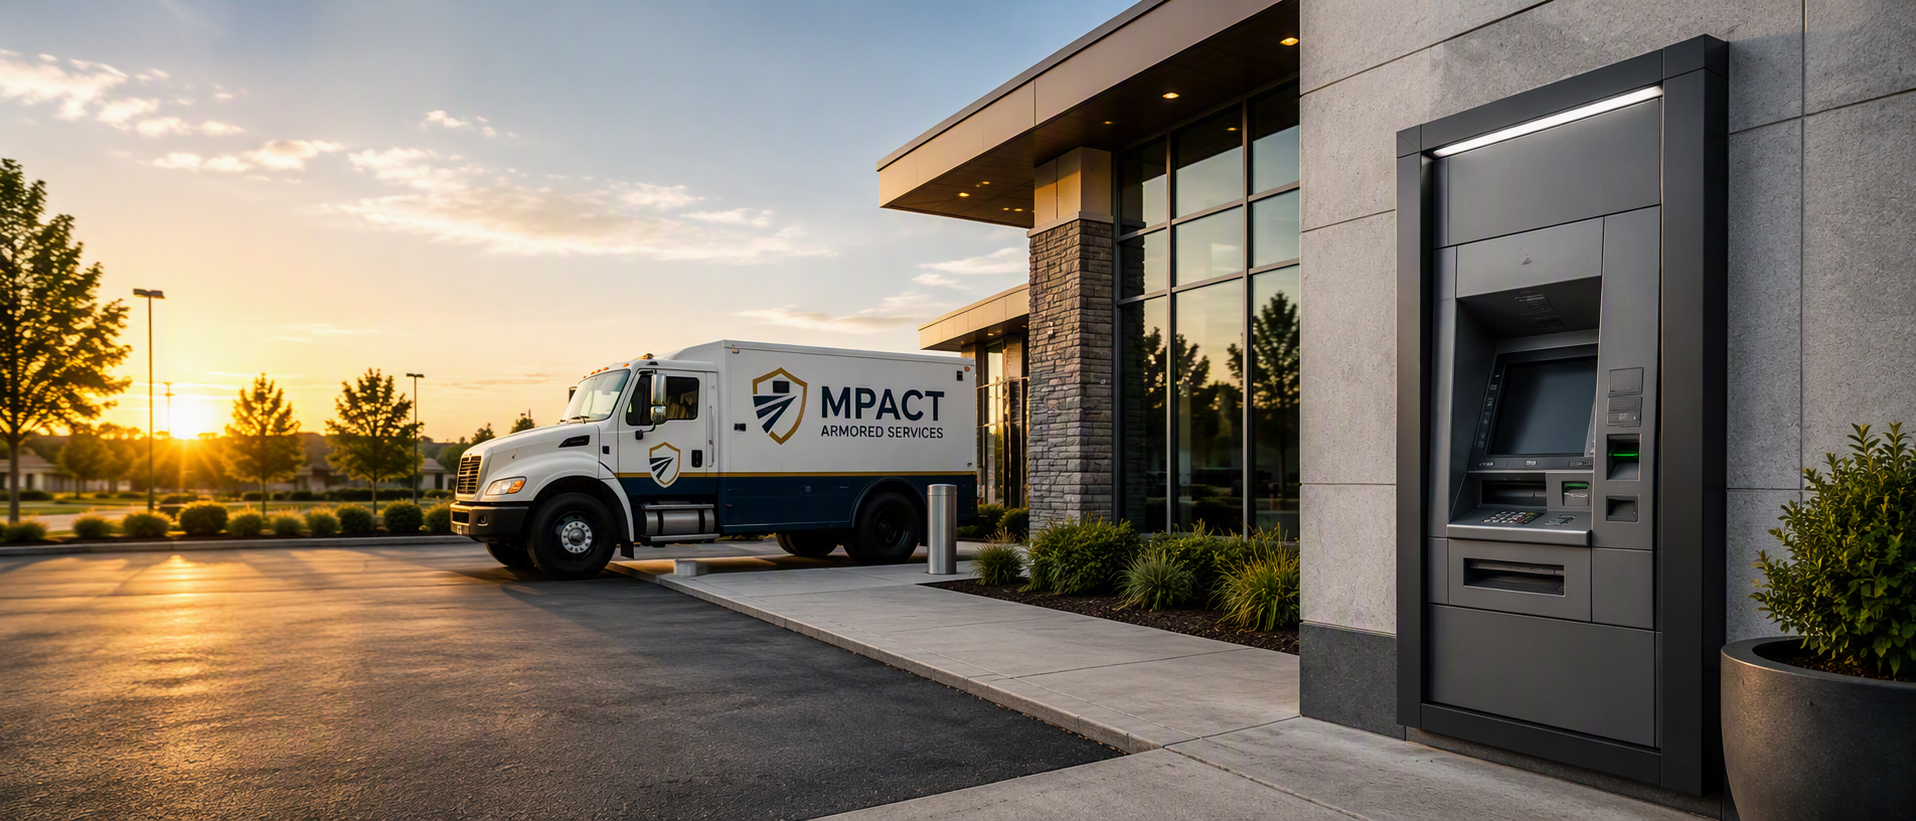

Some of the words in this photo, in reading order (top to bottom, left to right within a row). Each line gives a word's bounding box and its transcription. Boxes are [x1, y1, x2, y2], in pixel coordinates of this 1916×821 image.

[821, 386, 945, 421] MPACT
[821, 425, 884, 438] ARMORED
[887, 426, 944, 439] SERVICES
